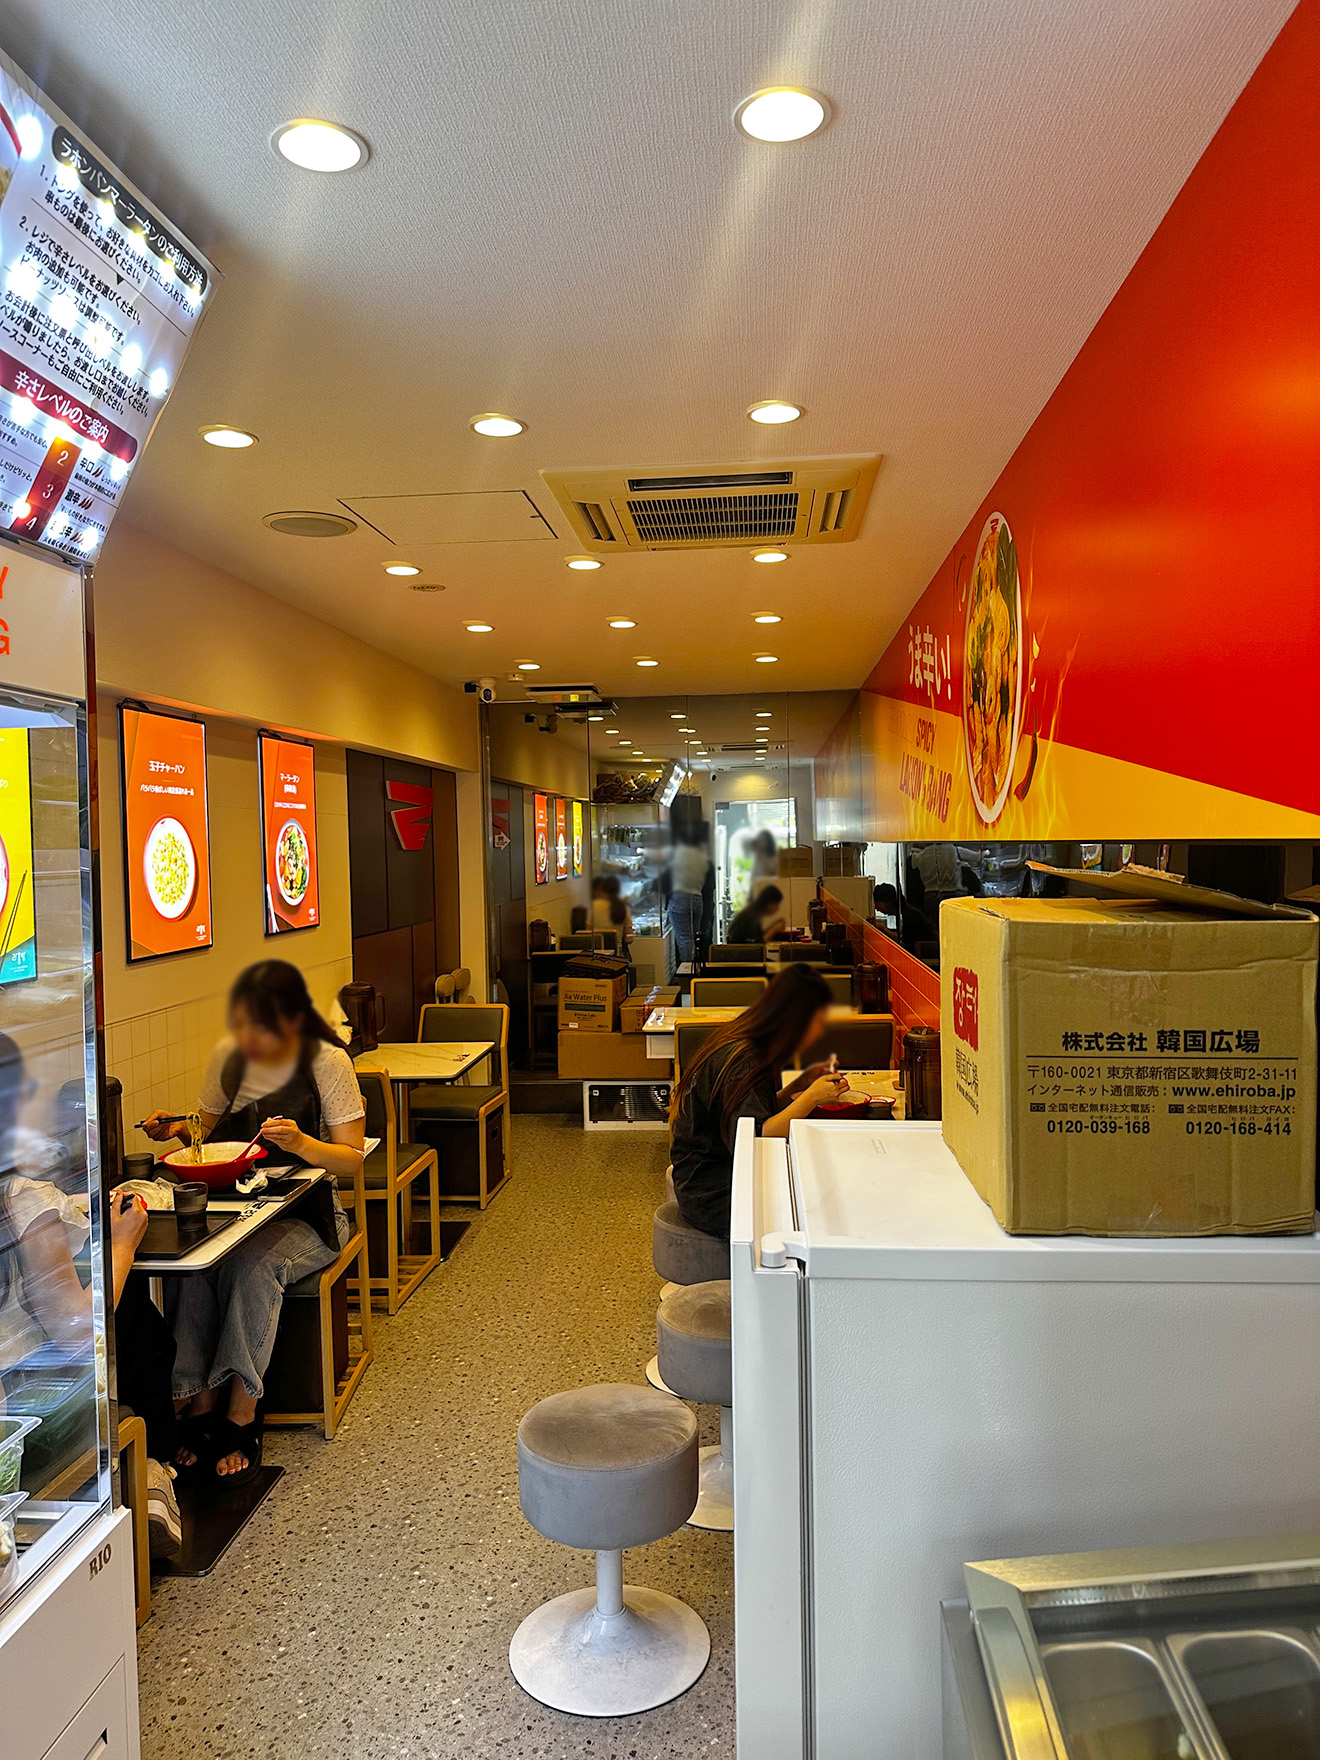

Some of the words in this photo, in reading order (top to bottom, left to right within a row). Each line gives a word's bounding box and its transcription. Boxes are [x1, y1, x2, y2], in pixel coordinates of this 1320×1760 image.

[14, 370, 110, 443] 辛さレベルのご案内
[57, 450, 69, 466] 2
[42, 484, 54, 499] 3
[26, 517, 38, 530] 4
[916, 718, 937, 754] SPICY
[149, 760, 185, 774] 玉子チャーハン
[1062, 1032, 1148, 1052] 株式会社
[1156, 1029, 1260, 1053] 韓国広場
[1107, 1066, 1297, 1081] 東京都新宿区歌舞伎町2-31-11
[1172, 1084, 1296, 1100] www.ehiroba.jp
[1047, 1120, 1150, 1134] 0120-039-168
[1186, 1121, 1292, 1135] 0120-168-414
[89, 1543, 112, 1581] RIO
